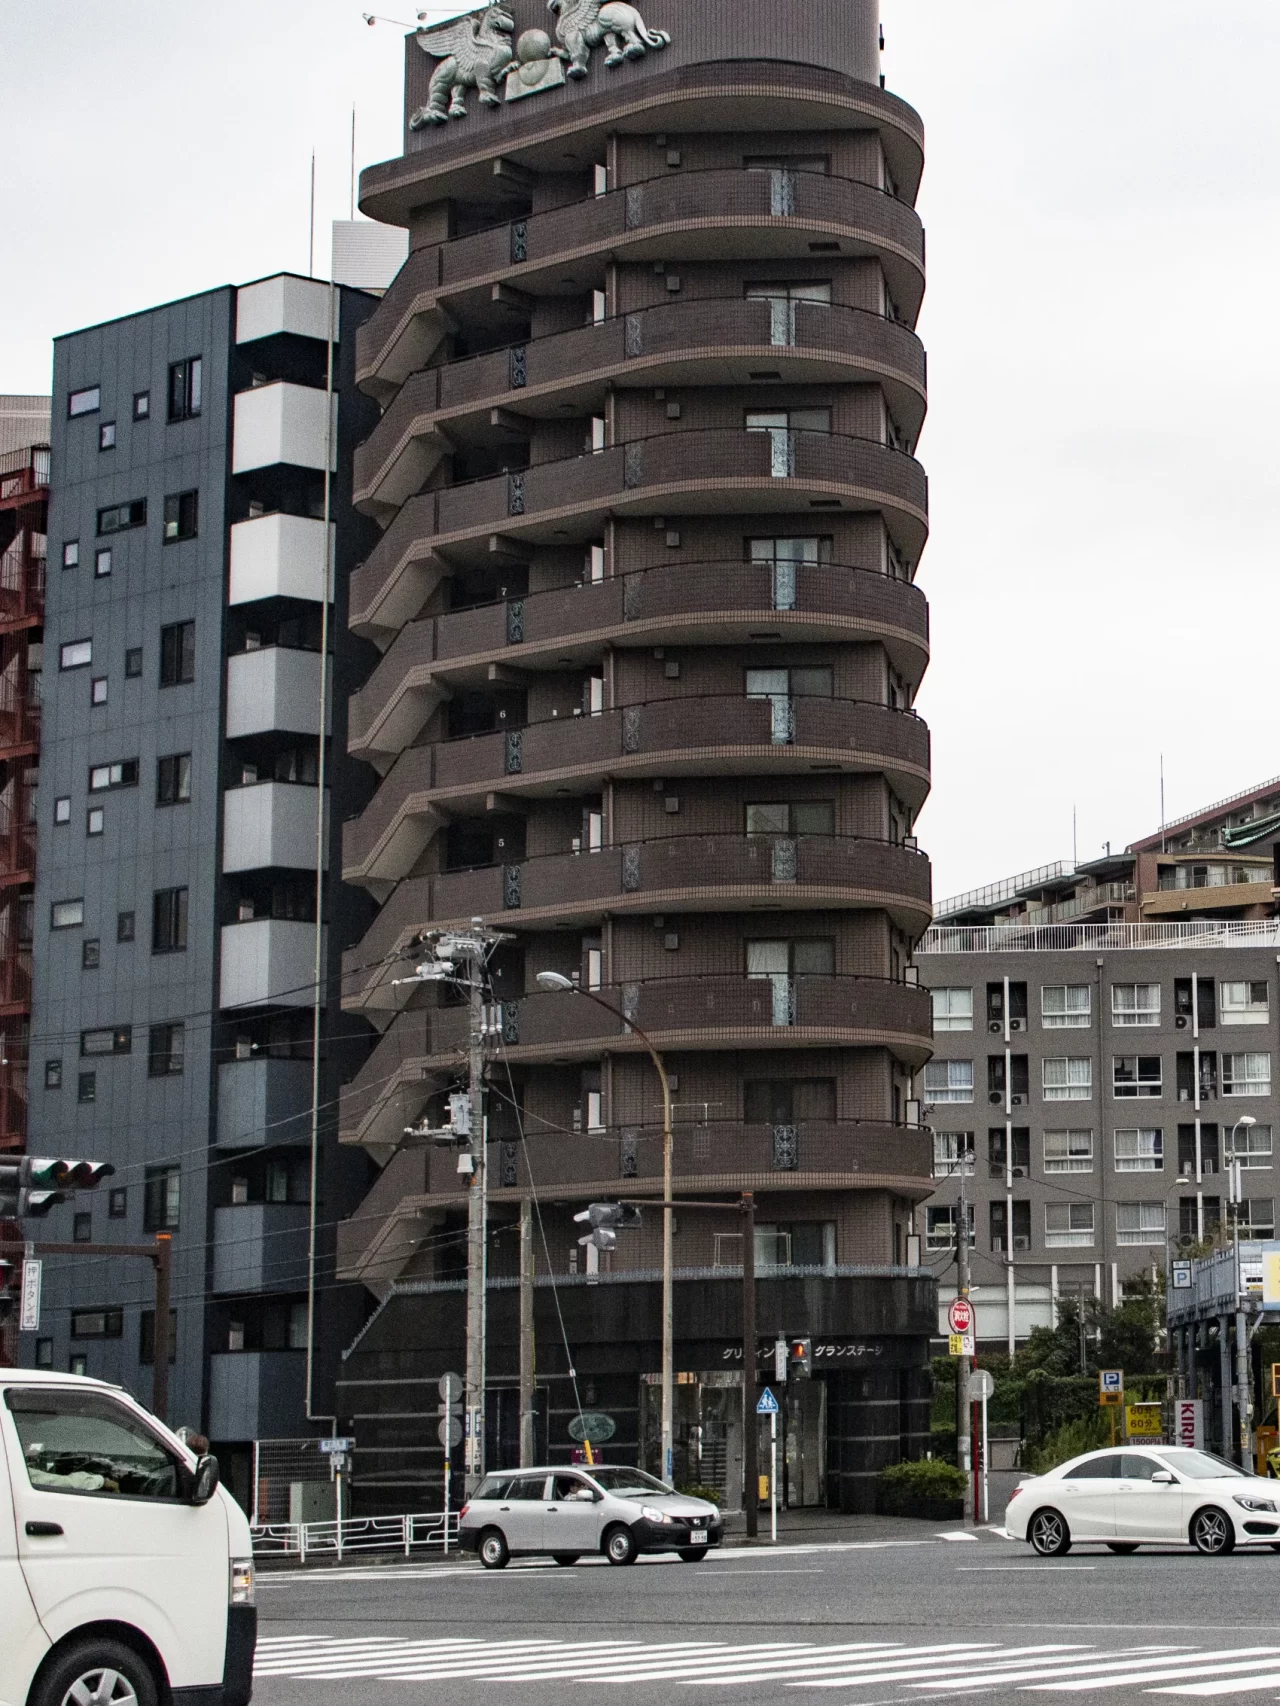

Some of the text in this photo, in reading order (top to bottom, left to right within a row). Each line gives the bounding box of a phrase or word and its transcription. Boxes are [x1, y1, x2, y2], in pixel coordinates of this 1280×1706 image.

[1177, 1272, 1187, 1284] P
[26, 1266, 37, 1325] 押ボタン式
[1106, 1373, 1117, 1384] P
